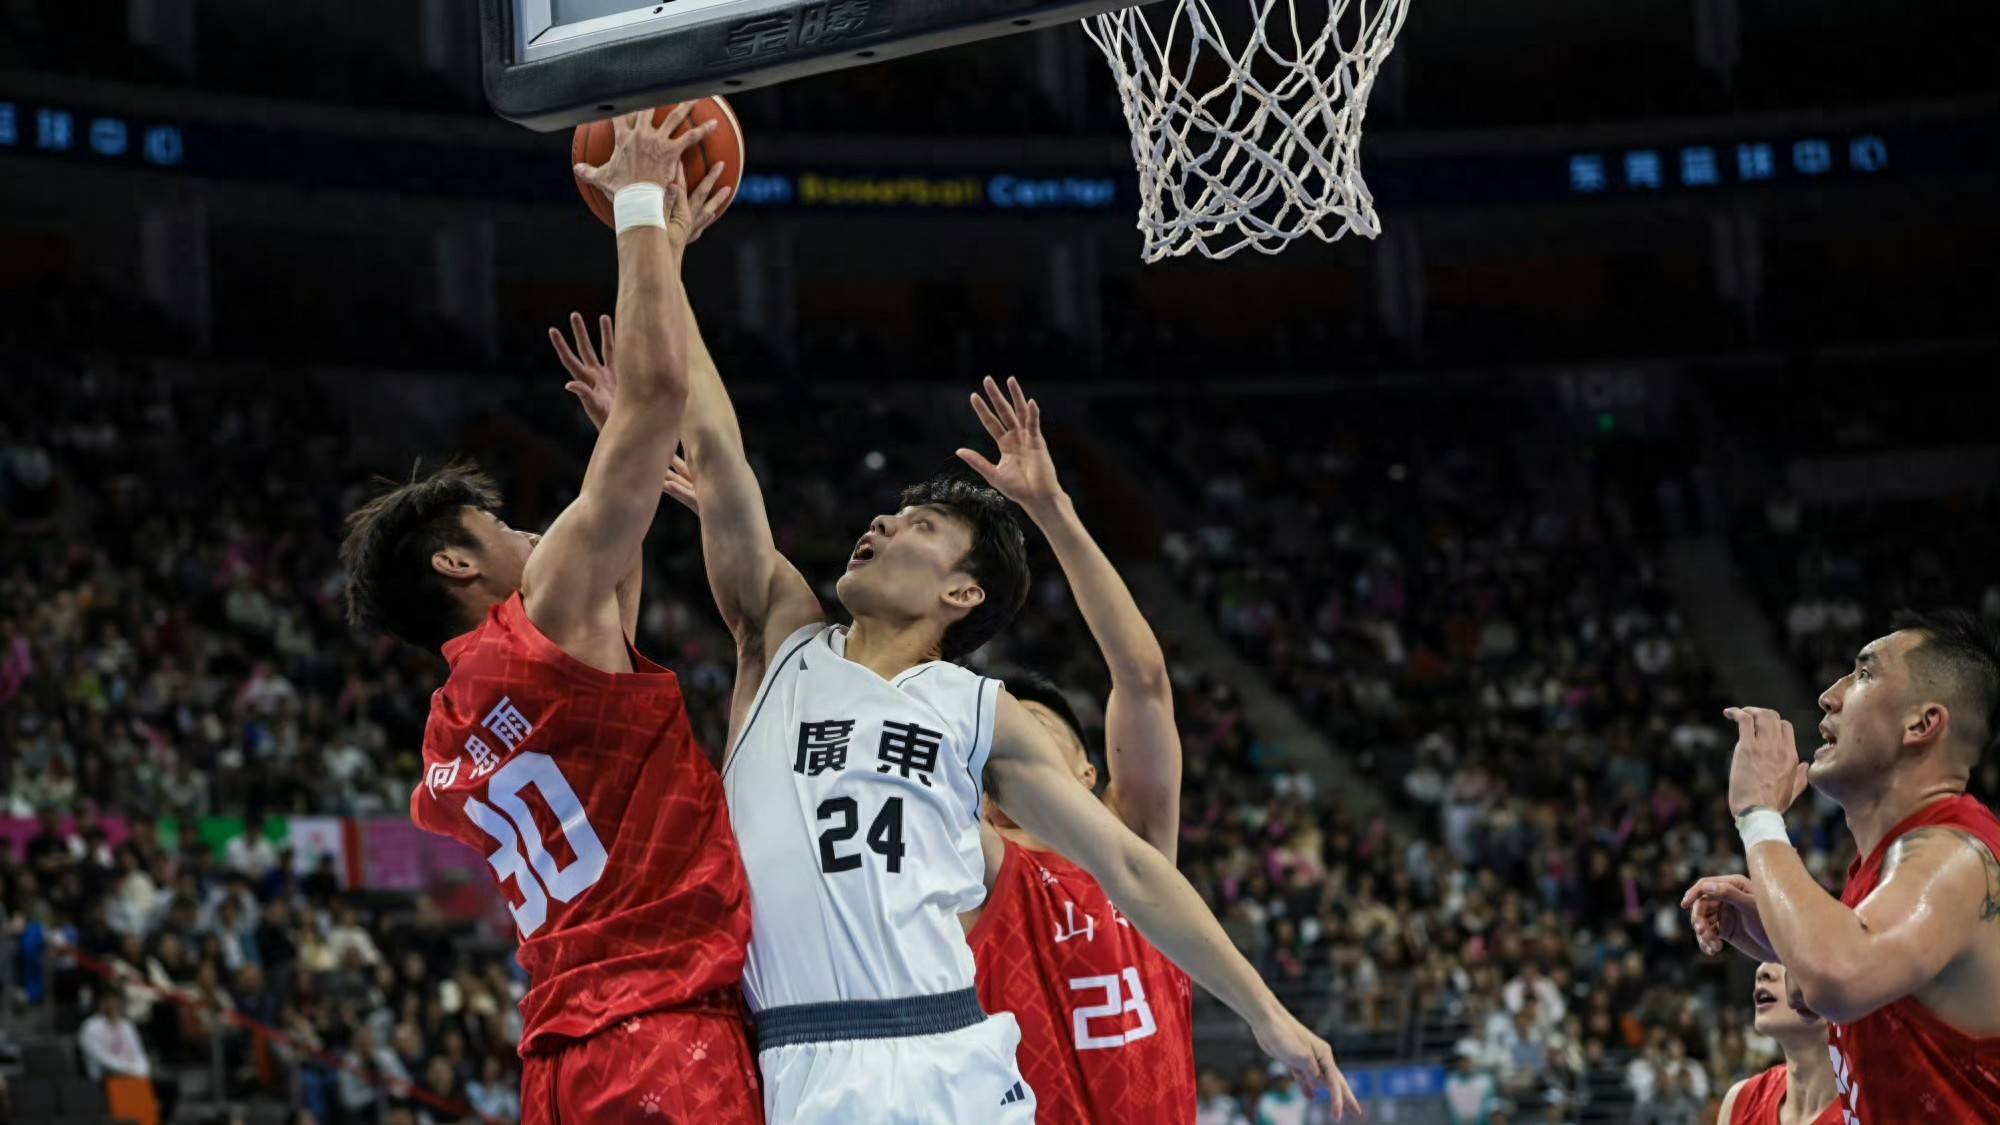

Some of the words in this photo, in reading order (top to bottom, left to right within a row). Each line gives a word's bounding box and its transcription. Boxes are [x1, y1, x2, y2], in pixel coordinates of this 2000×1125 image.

[987, 174, 1116, 207] Center
[793, 719, 943, 787] 廣東
[463, 751, 609, 940] 30
[817, 796, 905, 873] 24
[1069, 967, 1157, 1050] 23
